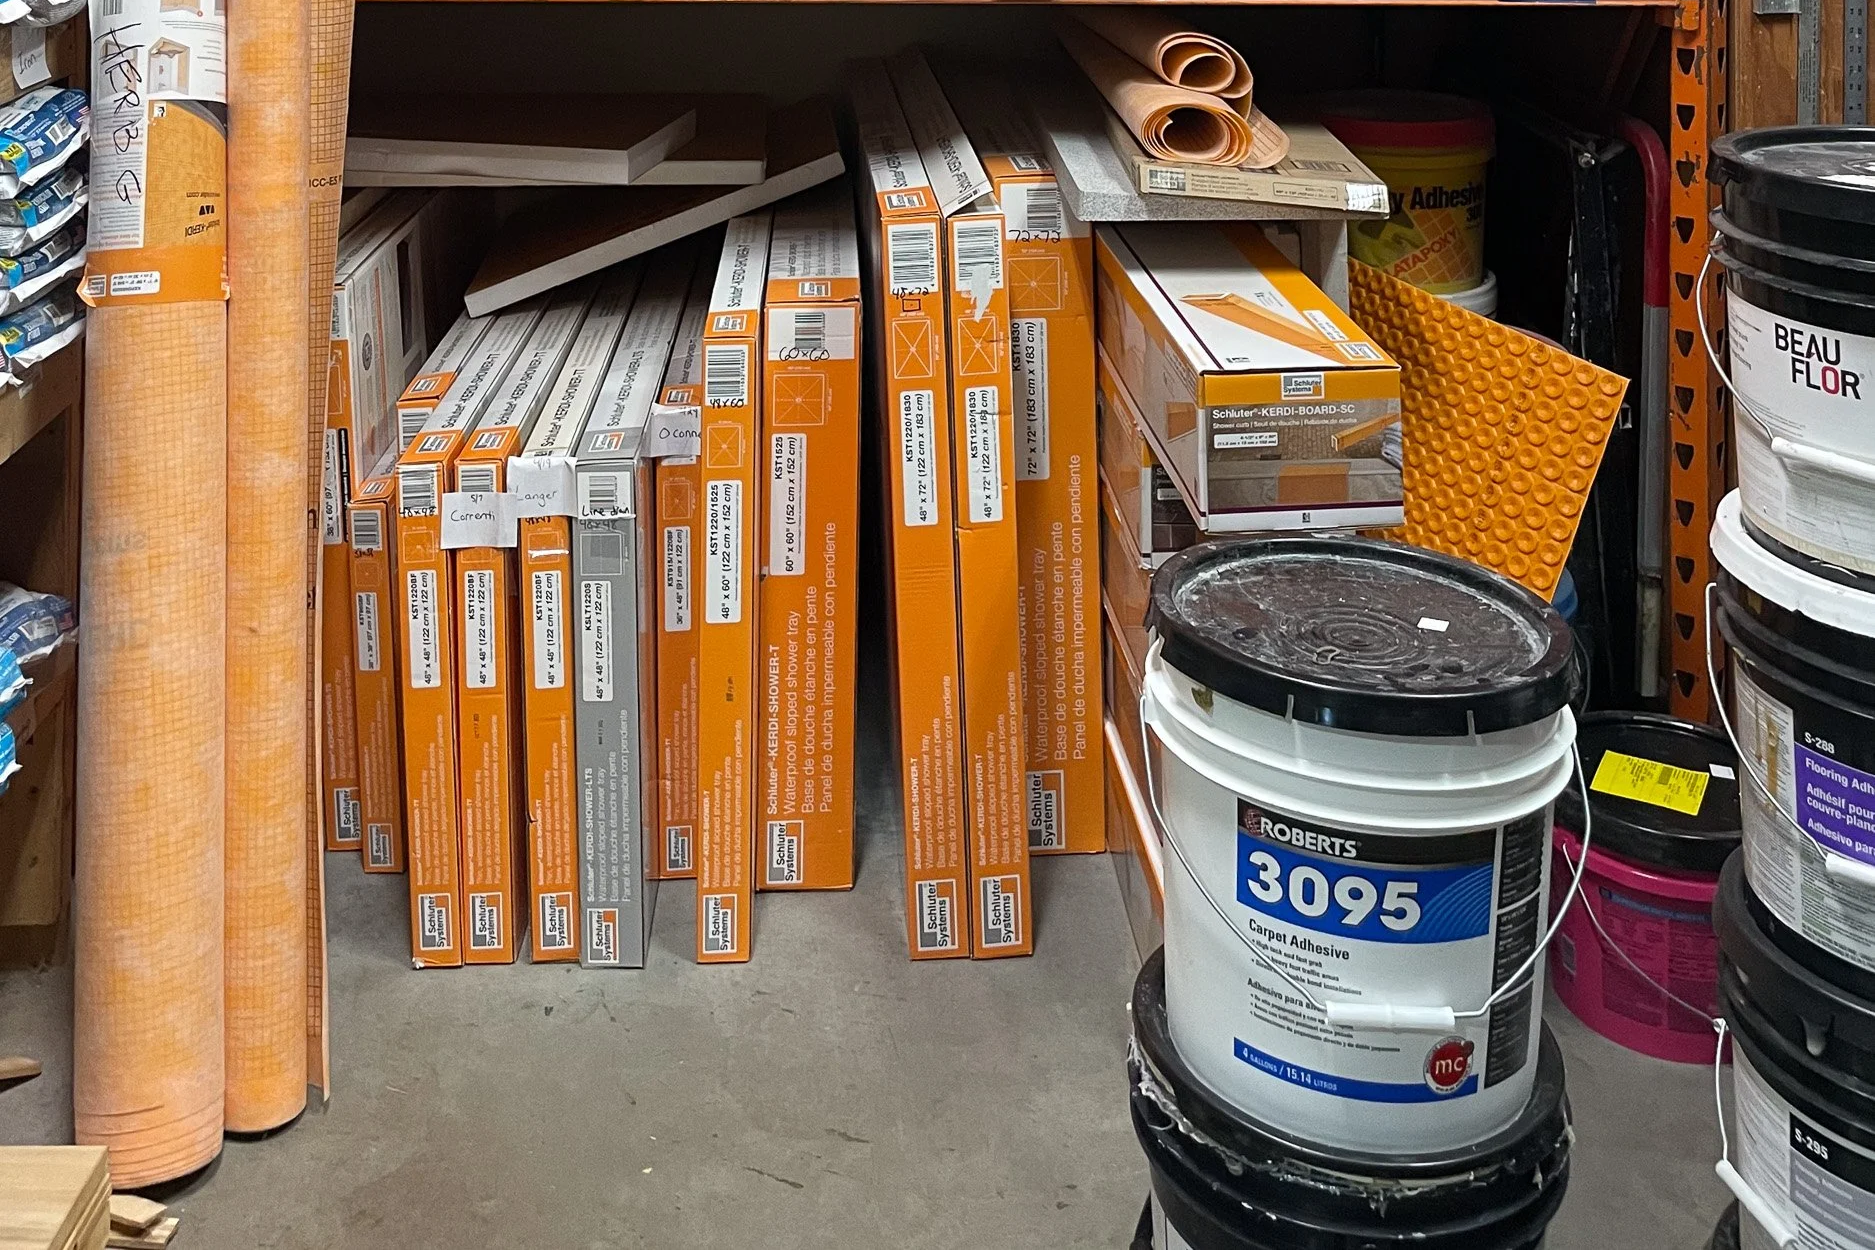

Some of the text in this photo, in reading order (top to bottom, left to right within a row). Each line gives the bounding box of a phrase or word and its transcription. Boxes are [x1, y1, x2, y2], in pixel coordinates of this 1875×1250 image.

[1774, 322, 1841, 366] BEAU
[1790, 355, 1862, 401] FLOR
[775, 436, 783, 480] KST1525
[1069, 454, 1086, 759] Panel de ducha impermeable con pendiente
[1033, 547, 1049, 762] Waterproof sloped shower tray
[1052, 521, 1067, 760] Base de douche étanche en pente
[820, 522, 838, 813] Panel de ducha impermeable con pendiente
[783, 610, 801, 814] Waterproof sloped shower tray
[802, 586, 819, 814] Base de douche étanche en pente
[1805, 757, 1849, 788] Flooring
[1032, 773, 1042, 827] Schluter
[1043, 792, 1054, 846] Systems
[776, 822, 785, 866] Schluter
[1260, 816, 1358, 858] ROBERTS
[1808, 818, 1853, 847] Adhesivo
[786, 838, 795, 881] Systems
[928, 882, 937, 930] Schluter
[992, 879, 1001, 926] Schluter
[1247, 850, 1422, 931] 3095
[428, 895, 436, 934] Schluter
[437, 909, 445, 947] Systems
[479, 895, 487, 934] Schluter
[488, 908, 496, 947] Systems
[549, 895, 557, 933] Schluter
[558, 908, 566, 947] Systems
[711, 896, 720, 936] Schluter
[720, 910, 728, 951] Systems
[938, 898, 947, 947] Systems
[1003, 894, 1012, 943] Systems
[1249, 918, 1350, 961] Carpet Adhesive
